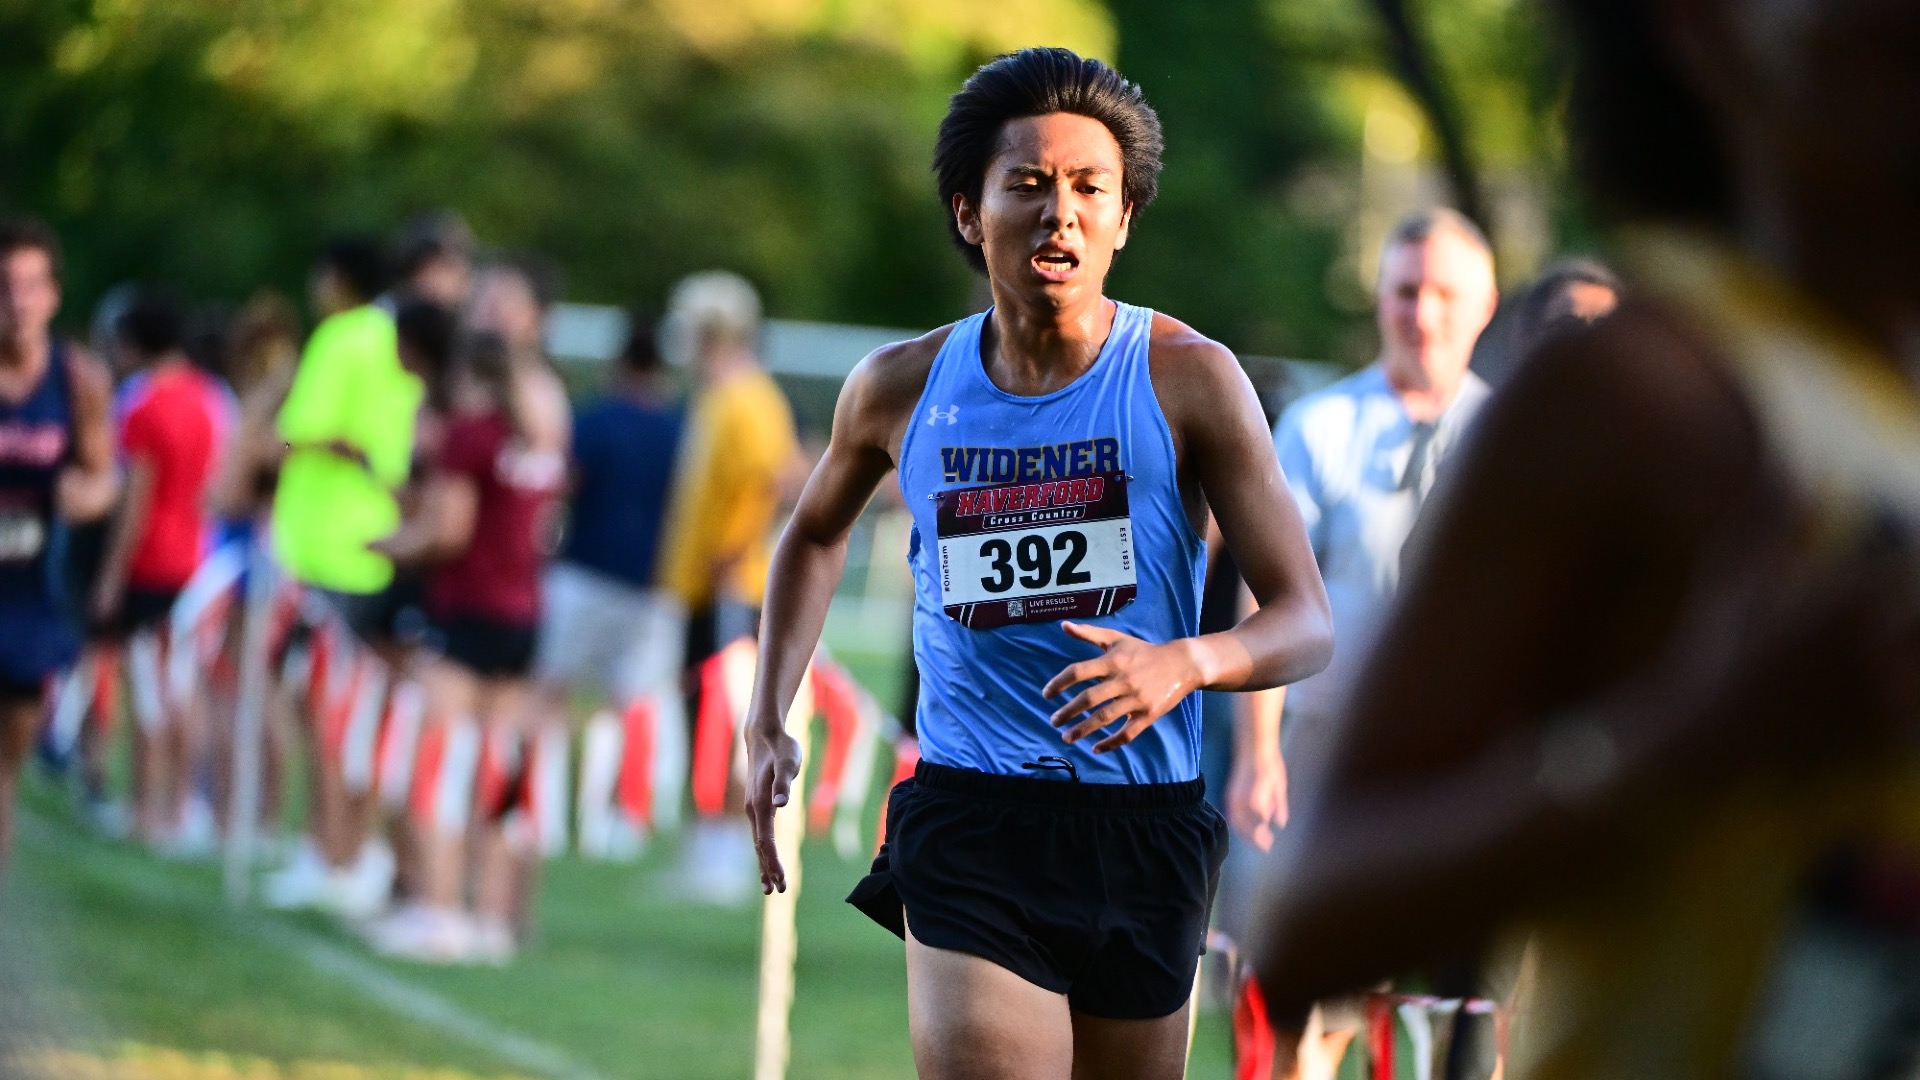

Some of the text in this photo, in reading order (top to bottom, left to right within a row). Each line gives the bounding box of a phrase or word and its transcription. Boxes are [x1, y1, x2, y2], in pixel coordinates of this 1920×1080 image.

[941, 437, 1120, 484] WIDENER
[956, 477, 1104, 517] HAVERFORD
[990, 510, 1079, 525] Cross Country
[942, 545, 951, 592] #OneTeam
[979, 531, 1091, 593] 392
[1119, 527, 1130, 571] EST. 1833
[1045, 597, 1075, 606] RESULTS
